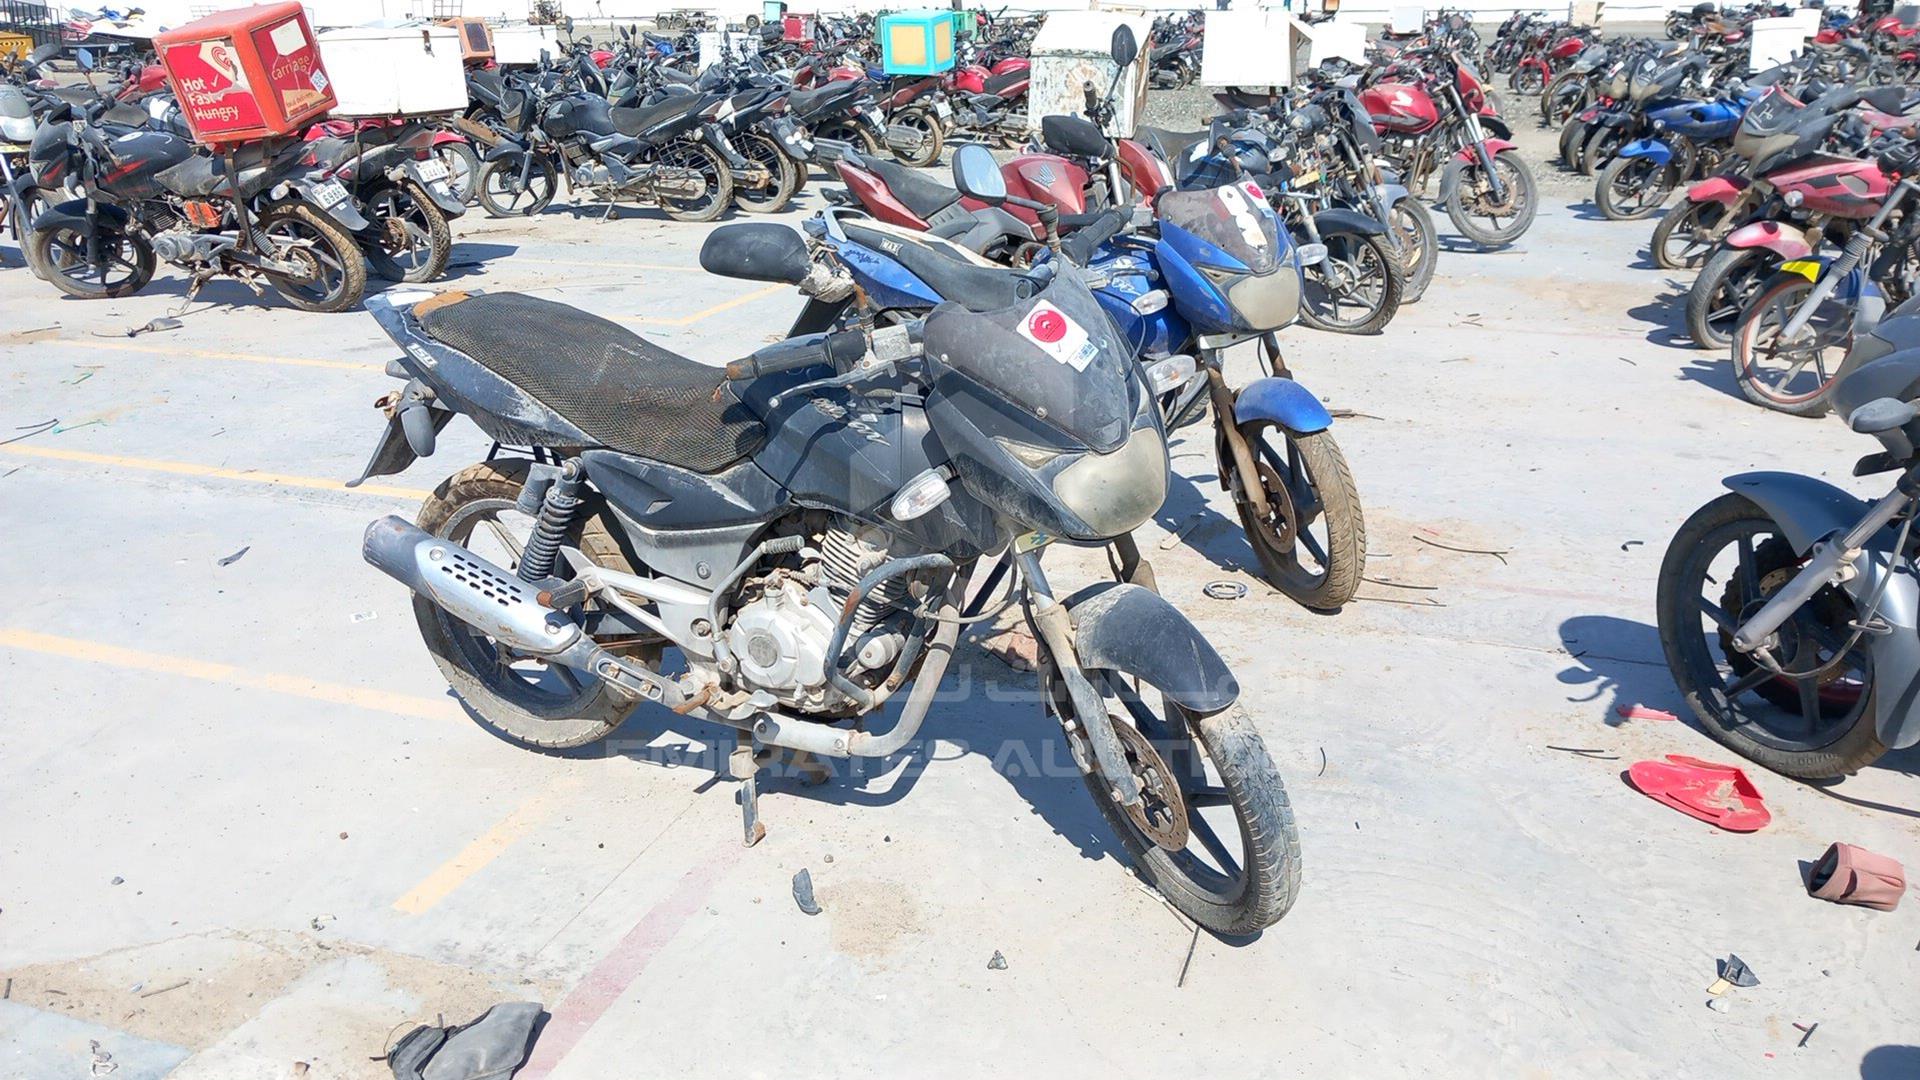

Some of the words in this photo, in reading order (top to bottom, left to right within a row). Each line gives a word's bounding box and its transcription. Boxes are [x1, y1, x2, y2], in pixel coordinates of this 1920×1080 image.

[271, 55, 311, 80] carriage
[181, 77, 207, 91] Hot
[188, 91, 217, 106] Fast
[193, 106, 239, 121] Hungry
